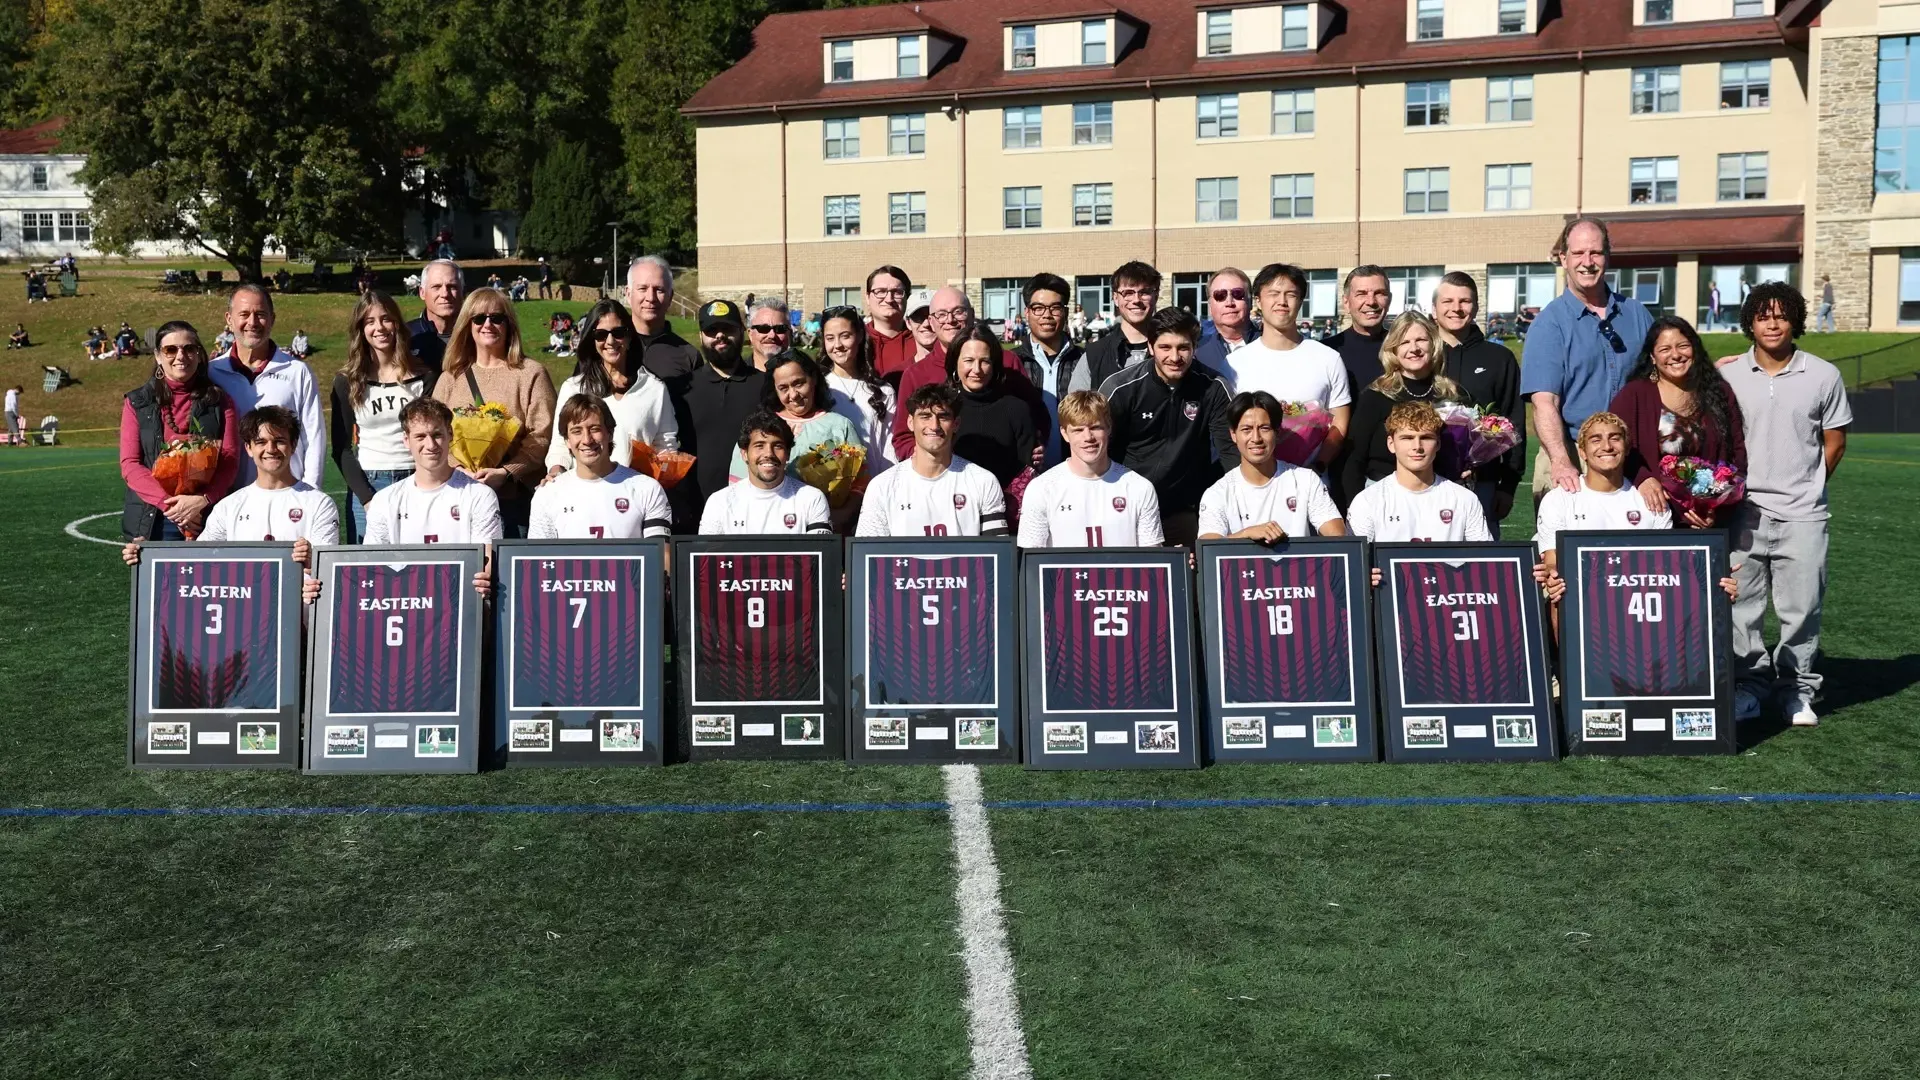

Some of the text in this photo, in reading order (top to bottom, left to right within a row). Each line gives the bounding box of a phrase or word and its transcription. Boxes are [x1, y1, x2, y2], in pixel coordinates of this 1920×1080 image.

[1085, 526, 1103, 547] 11
[540, 579, 616, 593] EASTERN
[718, 578, 793, 592] EASTERN
[894, 576, 968, 590] EASTERN
[1606, 573, 1681, 587] EASTERN
[178, 584, 252, 599] EASTERN
[1073, 589, 1149, 604] EASTERN
[1241, 585, 1316, 601] EASTERN
[1425, 592, 1499, 607] EASTERN
[358, 596, 433, 611] EASTERN
[569, 597, 588, 629] 7
[747, 597, 765, 628] 8
[922, 594, 940, 626] 5
[1627, 591, 1663, 623] 40
[204, 603, 223, 635] 3
[1093, 606, 1129, 637] 25
[1266, 604, 1294, 636] 18
[1451, 610, 1480, 641] 31
[385, 616, 404, 647] 6
